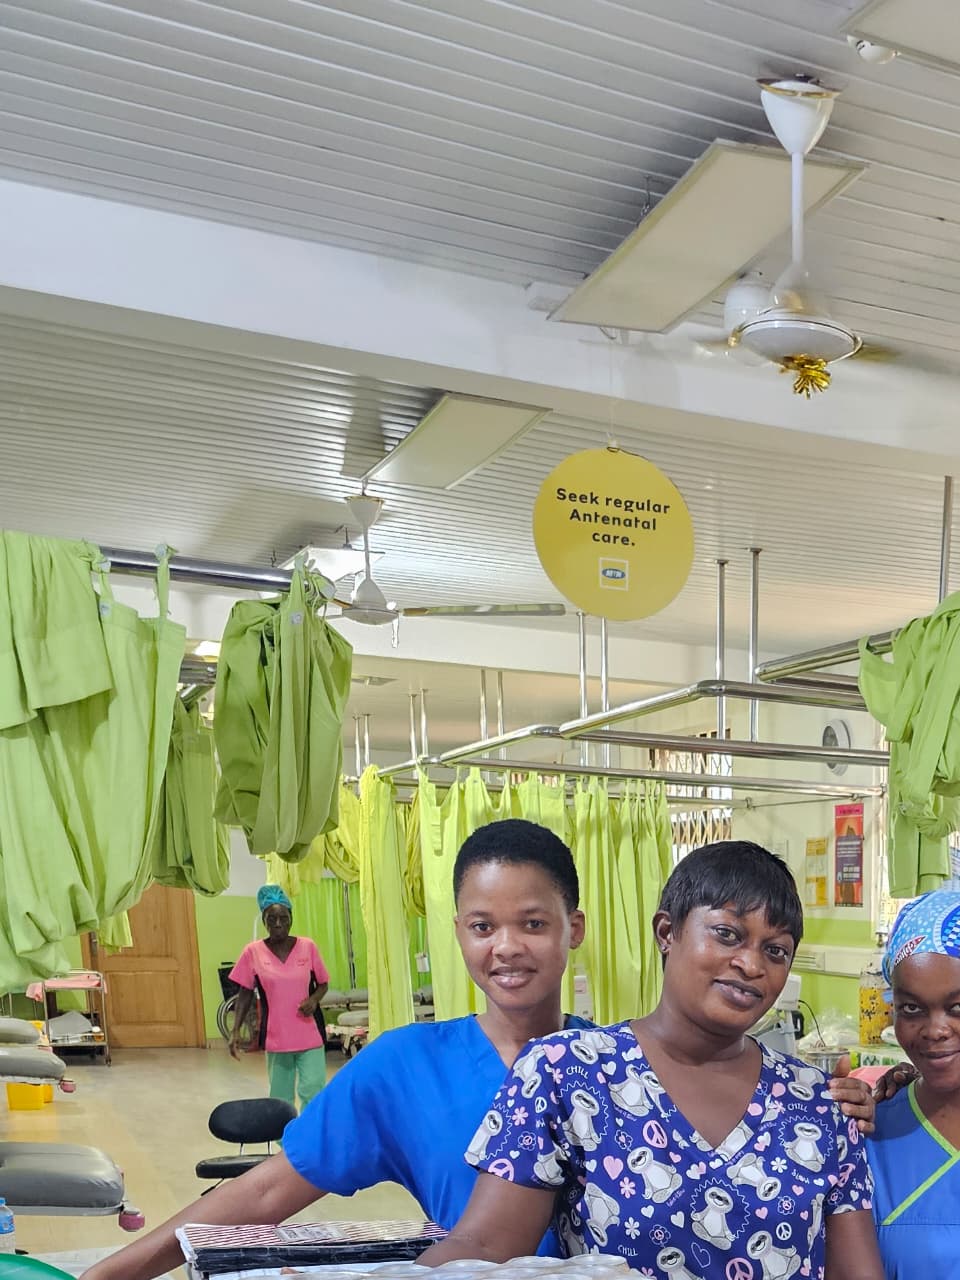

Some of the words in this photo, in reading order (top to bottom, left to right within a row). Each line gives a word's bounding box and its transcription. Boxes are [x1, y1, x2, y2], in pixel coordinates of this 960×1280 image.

[556, 488, 599, 505] Seek
[605, 496, 670, 513] regular
[569, 508, 656, 530] Antenatal
[592, 532, 635, 546] care.
[566, 1065, 589, 1079] CHILL
[617, 1245, 639, 1256] CHILL
